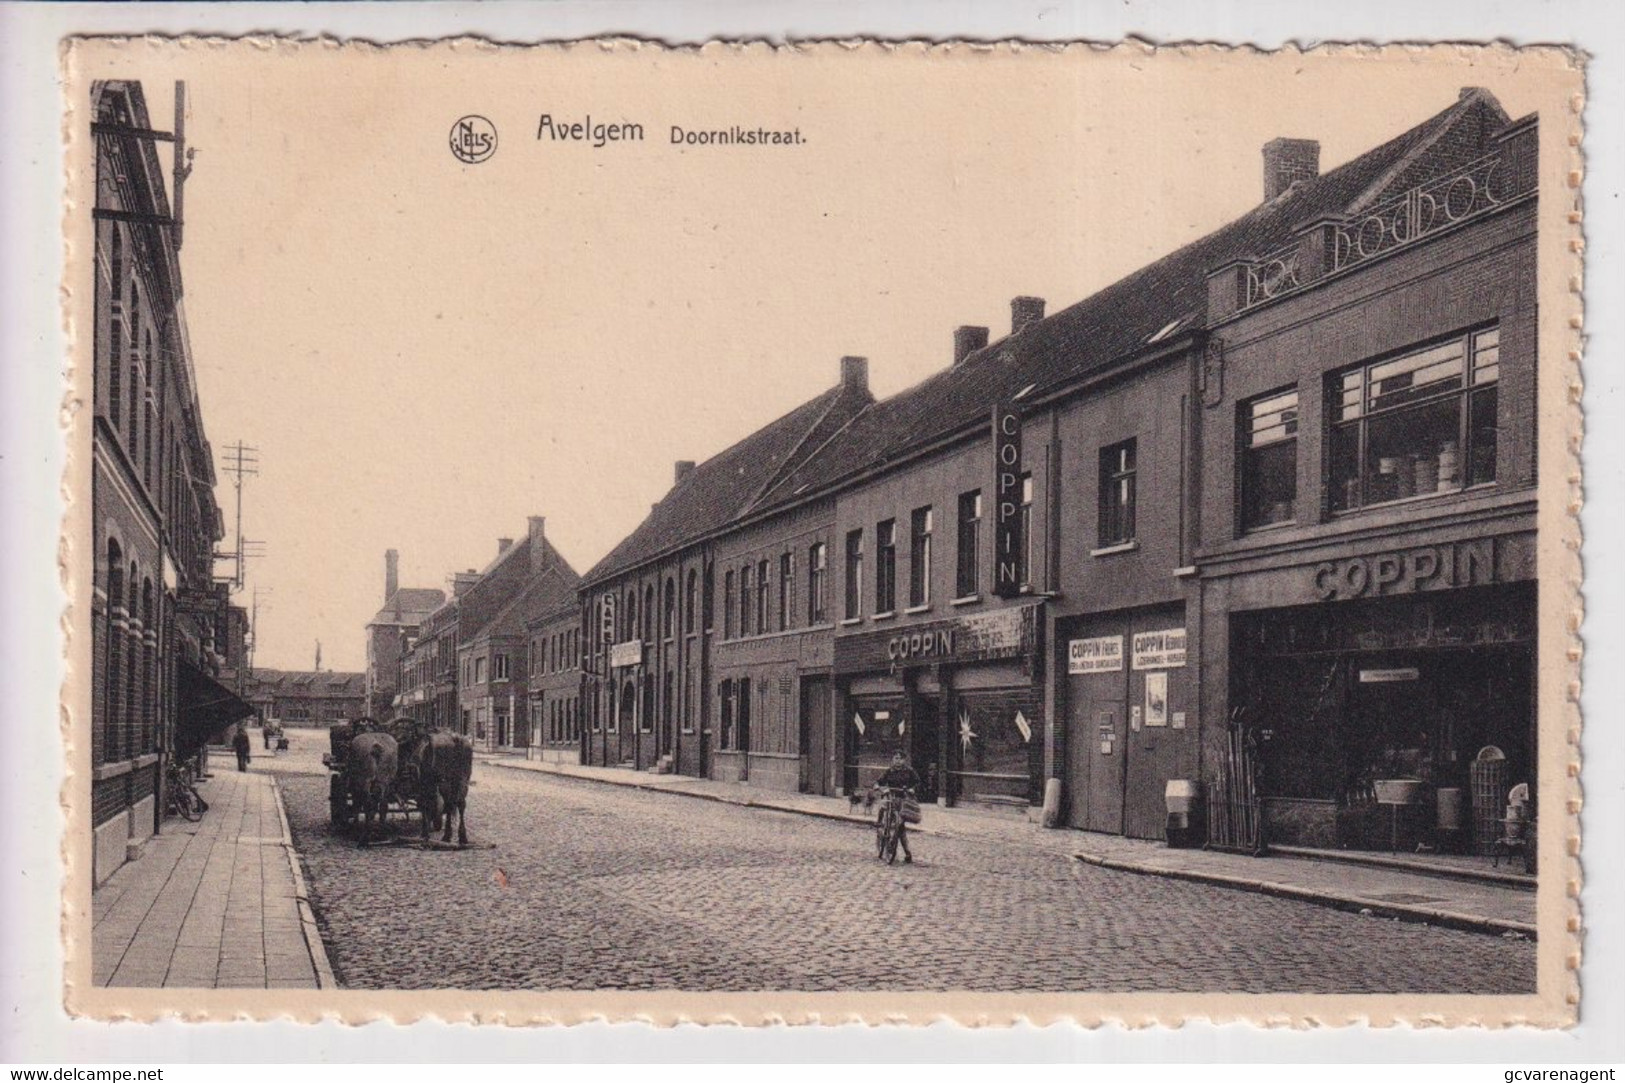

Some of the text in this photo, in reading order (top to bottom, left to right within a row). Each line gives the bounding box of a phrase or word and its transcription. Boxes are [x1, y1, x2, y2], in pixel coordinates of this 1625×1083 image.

[1001, 414, 1017, 583] COPPIN
[1314, 539, 1496, 600] COPPIN
[888, 630, 951, 660] COPPIN
[1072, 641, 1100, 658] COPPIN
[1135, 635, 1164, 653] COPPIN
